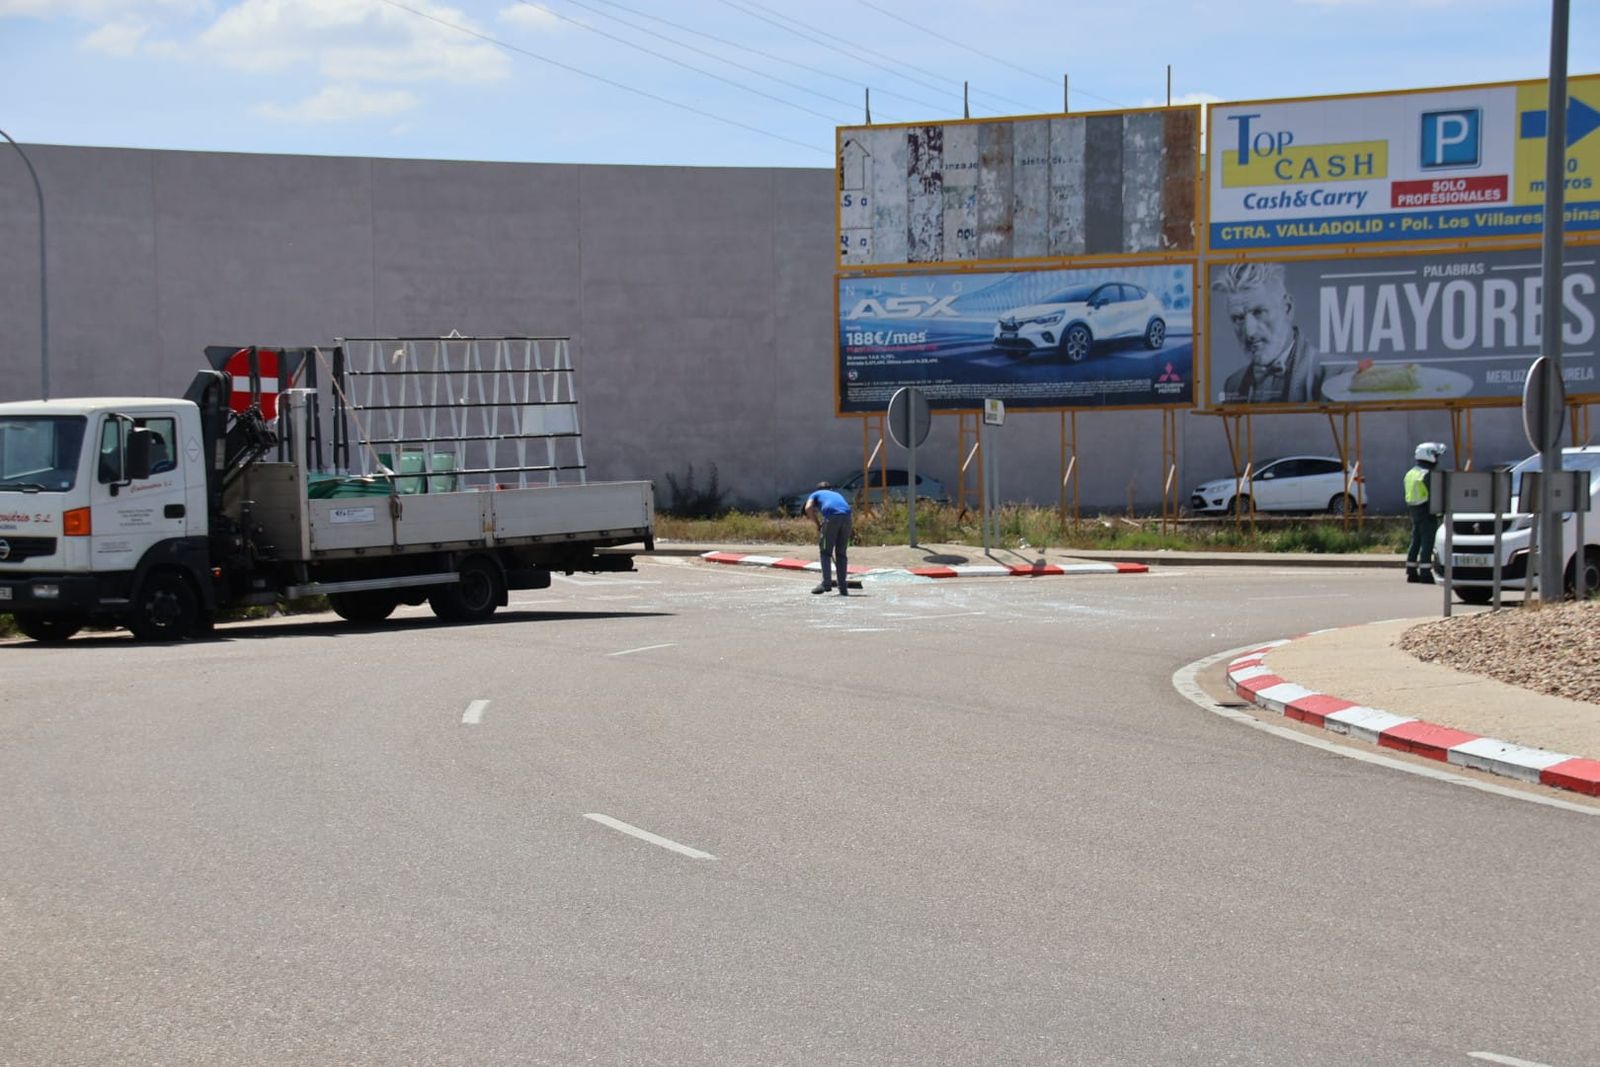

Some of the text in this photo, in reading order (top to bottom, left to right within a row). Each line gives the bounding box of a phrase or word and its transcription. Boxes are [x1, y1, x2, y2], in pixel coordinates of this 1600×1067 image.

[1434, 114, 1469, 164] P
[1274, 152, 1375, 181] CASH
[1397, 188, 1502, 206] PROFESIONALES
[1529, 176, 1593, 193] mros
[1242, 188, 1368, 211] Cash&Carry
[1220, 223, 1271, 241] CTRA.
[1275, 218, 1384, 238] VALLADOLID
[1400, 215, 1434, 232] Pol.
[1438, 213, 1471, 230] Los
[1474, 208, 1544, 228] Villares
[1423, 263, 1485, 277] PALABRAS
[847, 294, 961, 321] ASX
[1319, 272, 1596, 354] MAYORES
